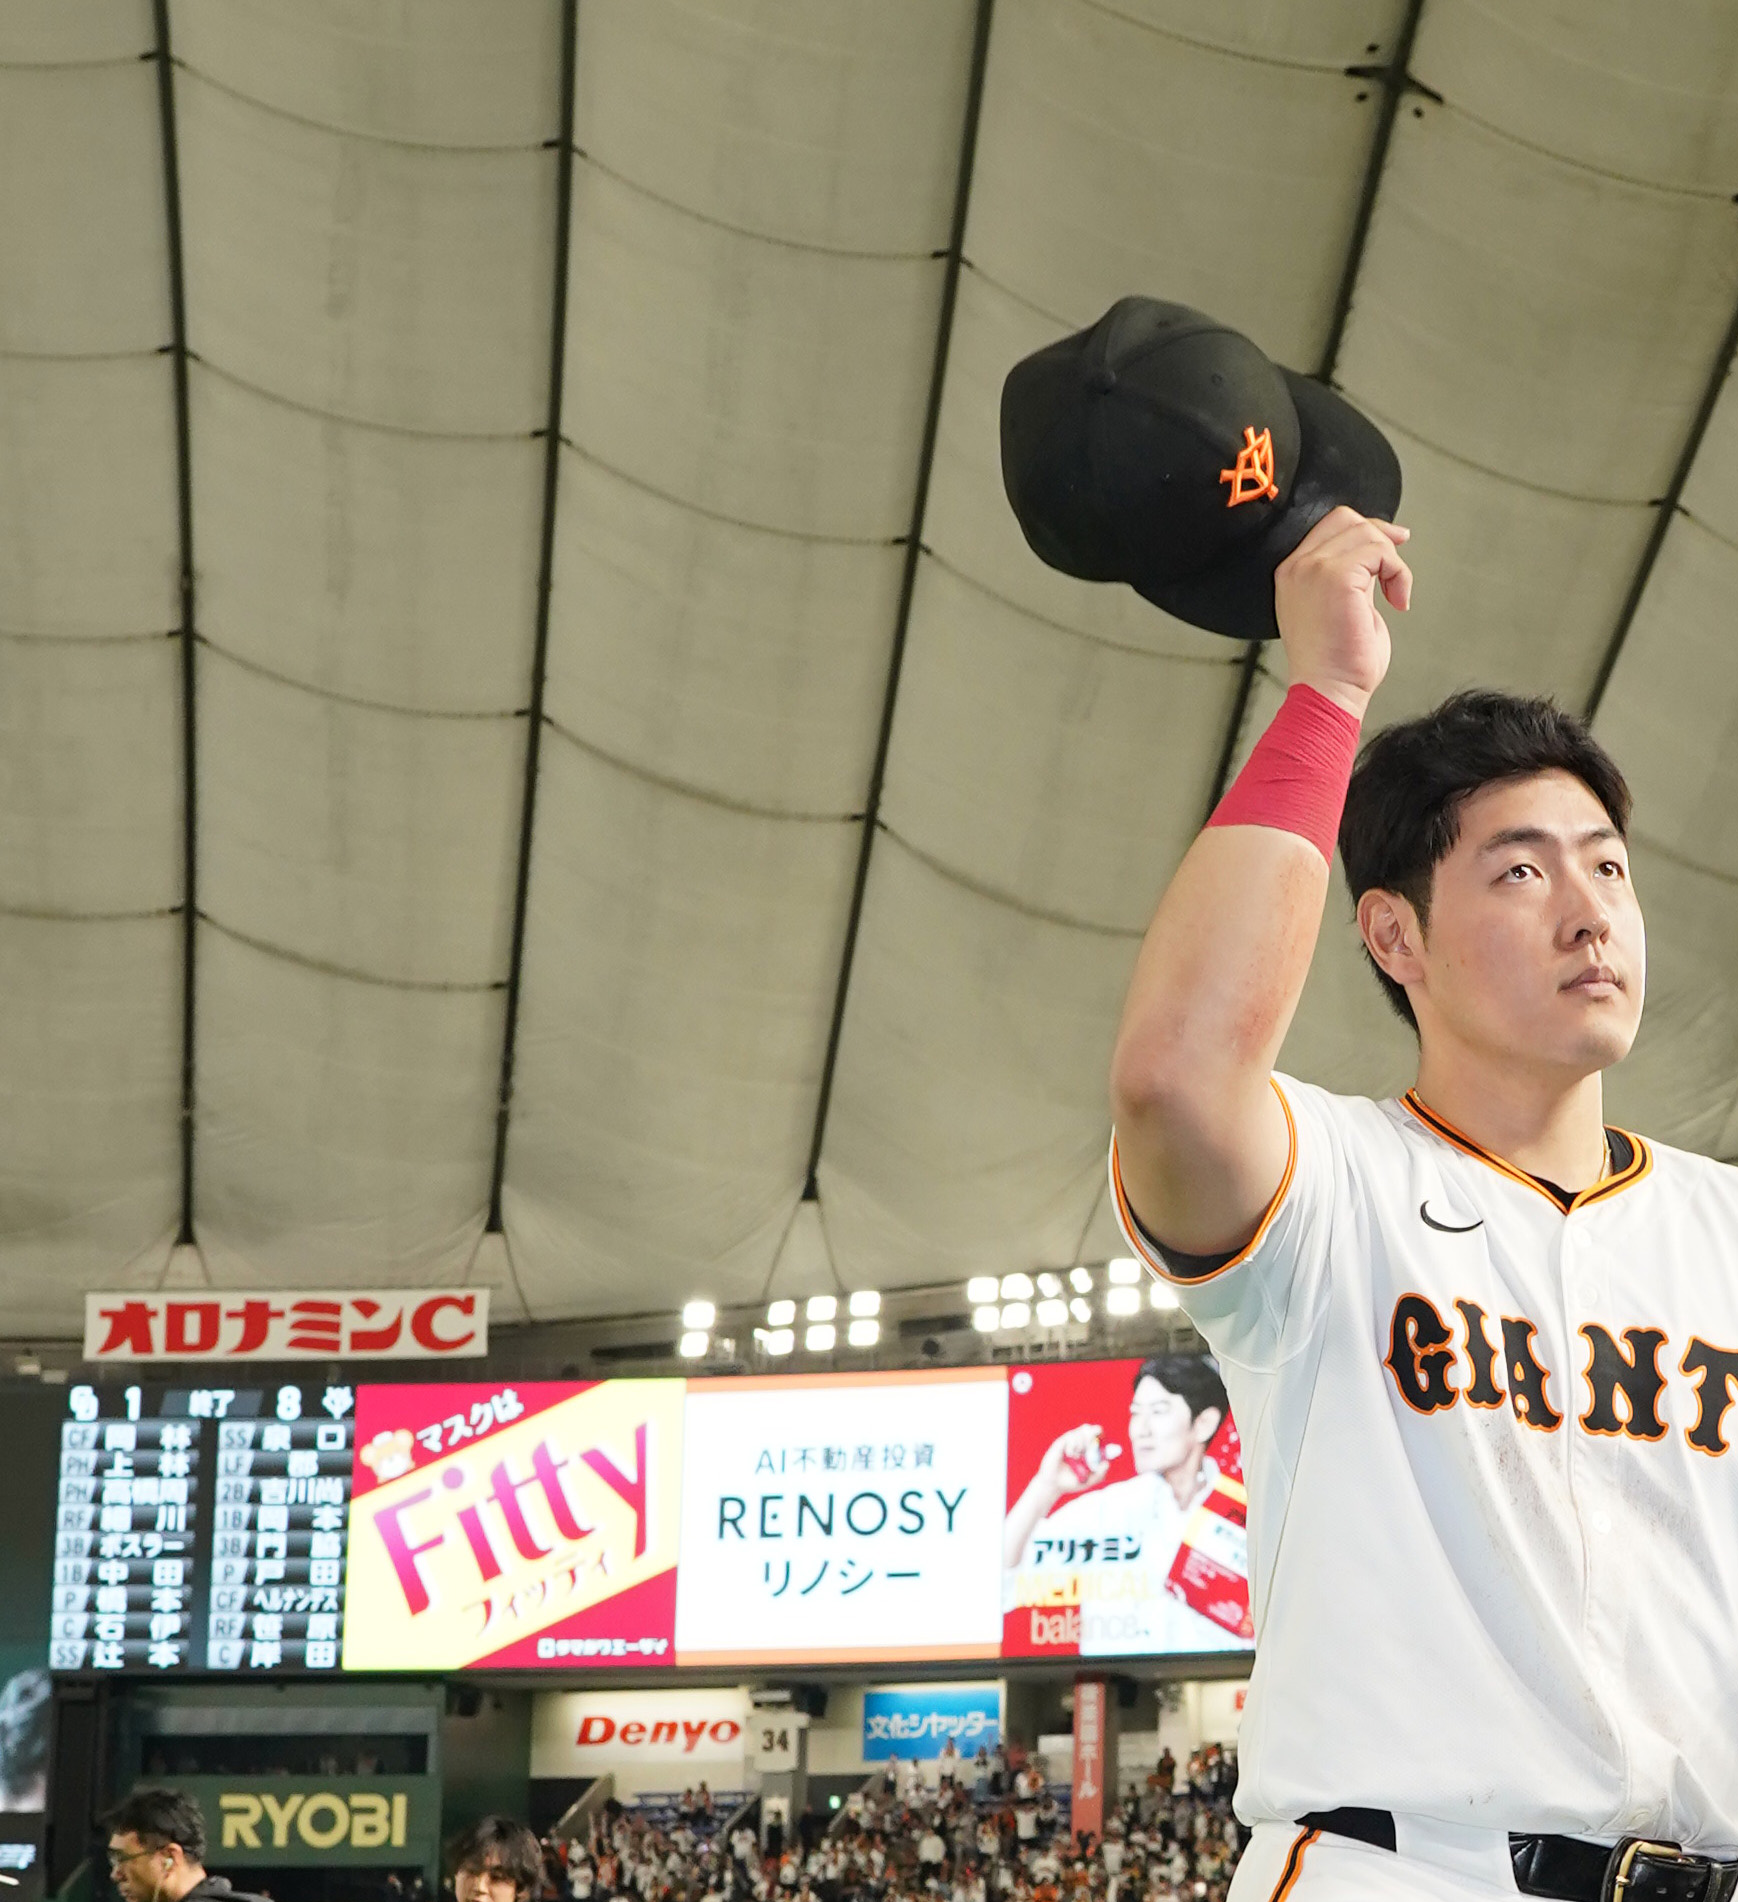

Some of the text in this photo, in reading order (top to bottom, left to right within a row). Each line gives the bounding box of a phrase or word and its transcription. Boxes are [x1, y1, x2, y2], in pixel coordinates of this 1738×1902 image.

[96, 1294, 476, 1355] オロナミンC
[125, 1386, 141, 1420] 1
[277, 1385, 301, 1420] 8
[415, 1388, 525, 1454] マスクは
[755, 1443, 936, 1475] AI不動産投資
[373, 1421, 648, 1616] Fitty
[718, 1488, 968, 1540] RENOSY
[1033, 1536, 1142, 1564] アリナミン
[98, 1559, 184, 1586] 中田
[763, 1558, 921, 1598] リノシー
[576, 1716, 740, 1753] Denyo
[761, 1728, 789, 1754] 34
[220, 1792, 406, 1849] RYOBI
